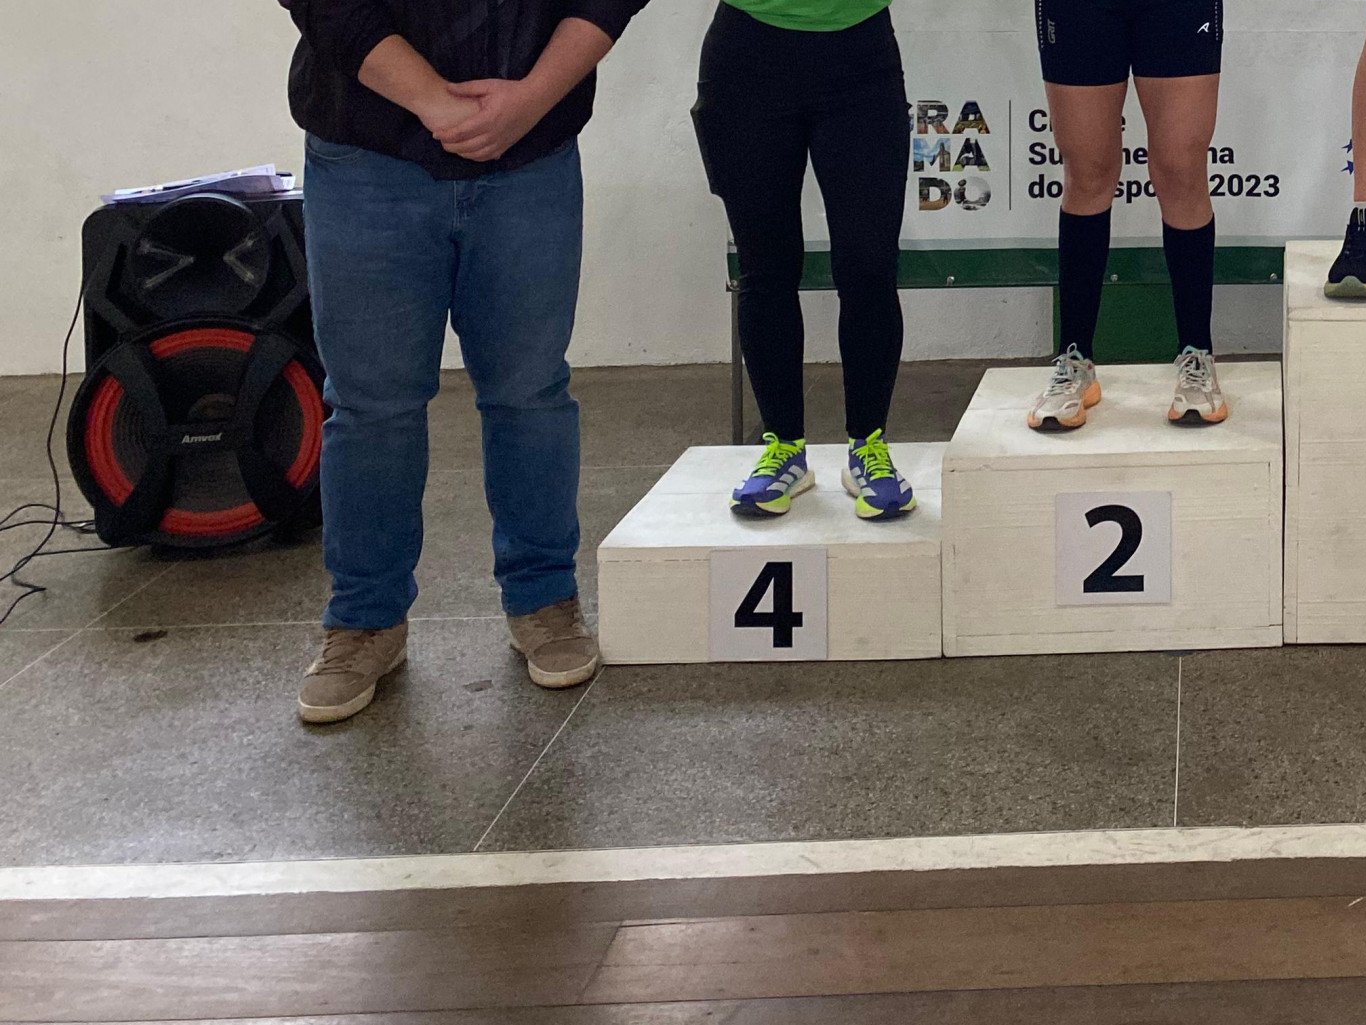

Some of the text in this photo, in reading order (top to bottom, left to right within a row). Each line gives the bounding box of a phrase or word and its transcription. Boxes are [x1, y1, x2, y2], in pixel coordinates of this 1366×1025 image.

[913, 138, 991, 172] MA
[919, 176, 991, 211] DO
[1028, 174, 1063, 198] do
[1209, 174, 1280, 197] 2023
[1082, 503, 1146, 594] 2
[734, 561, 804, 648] 4
